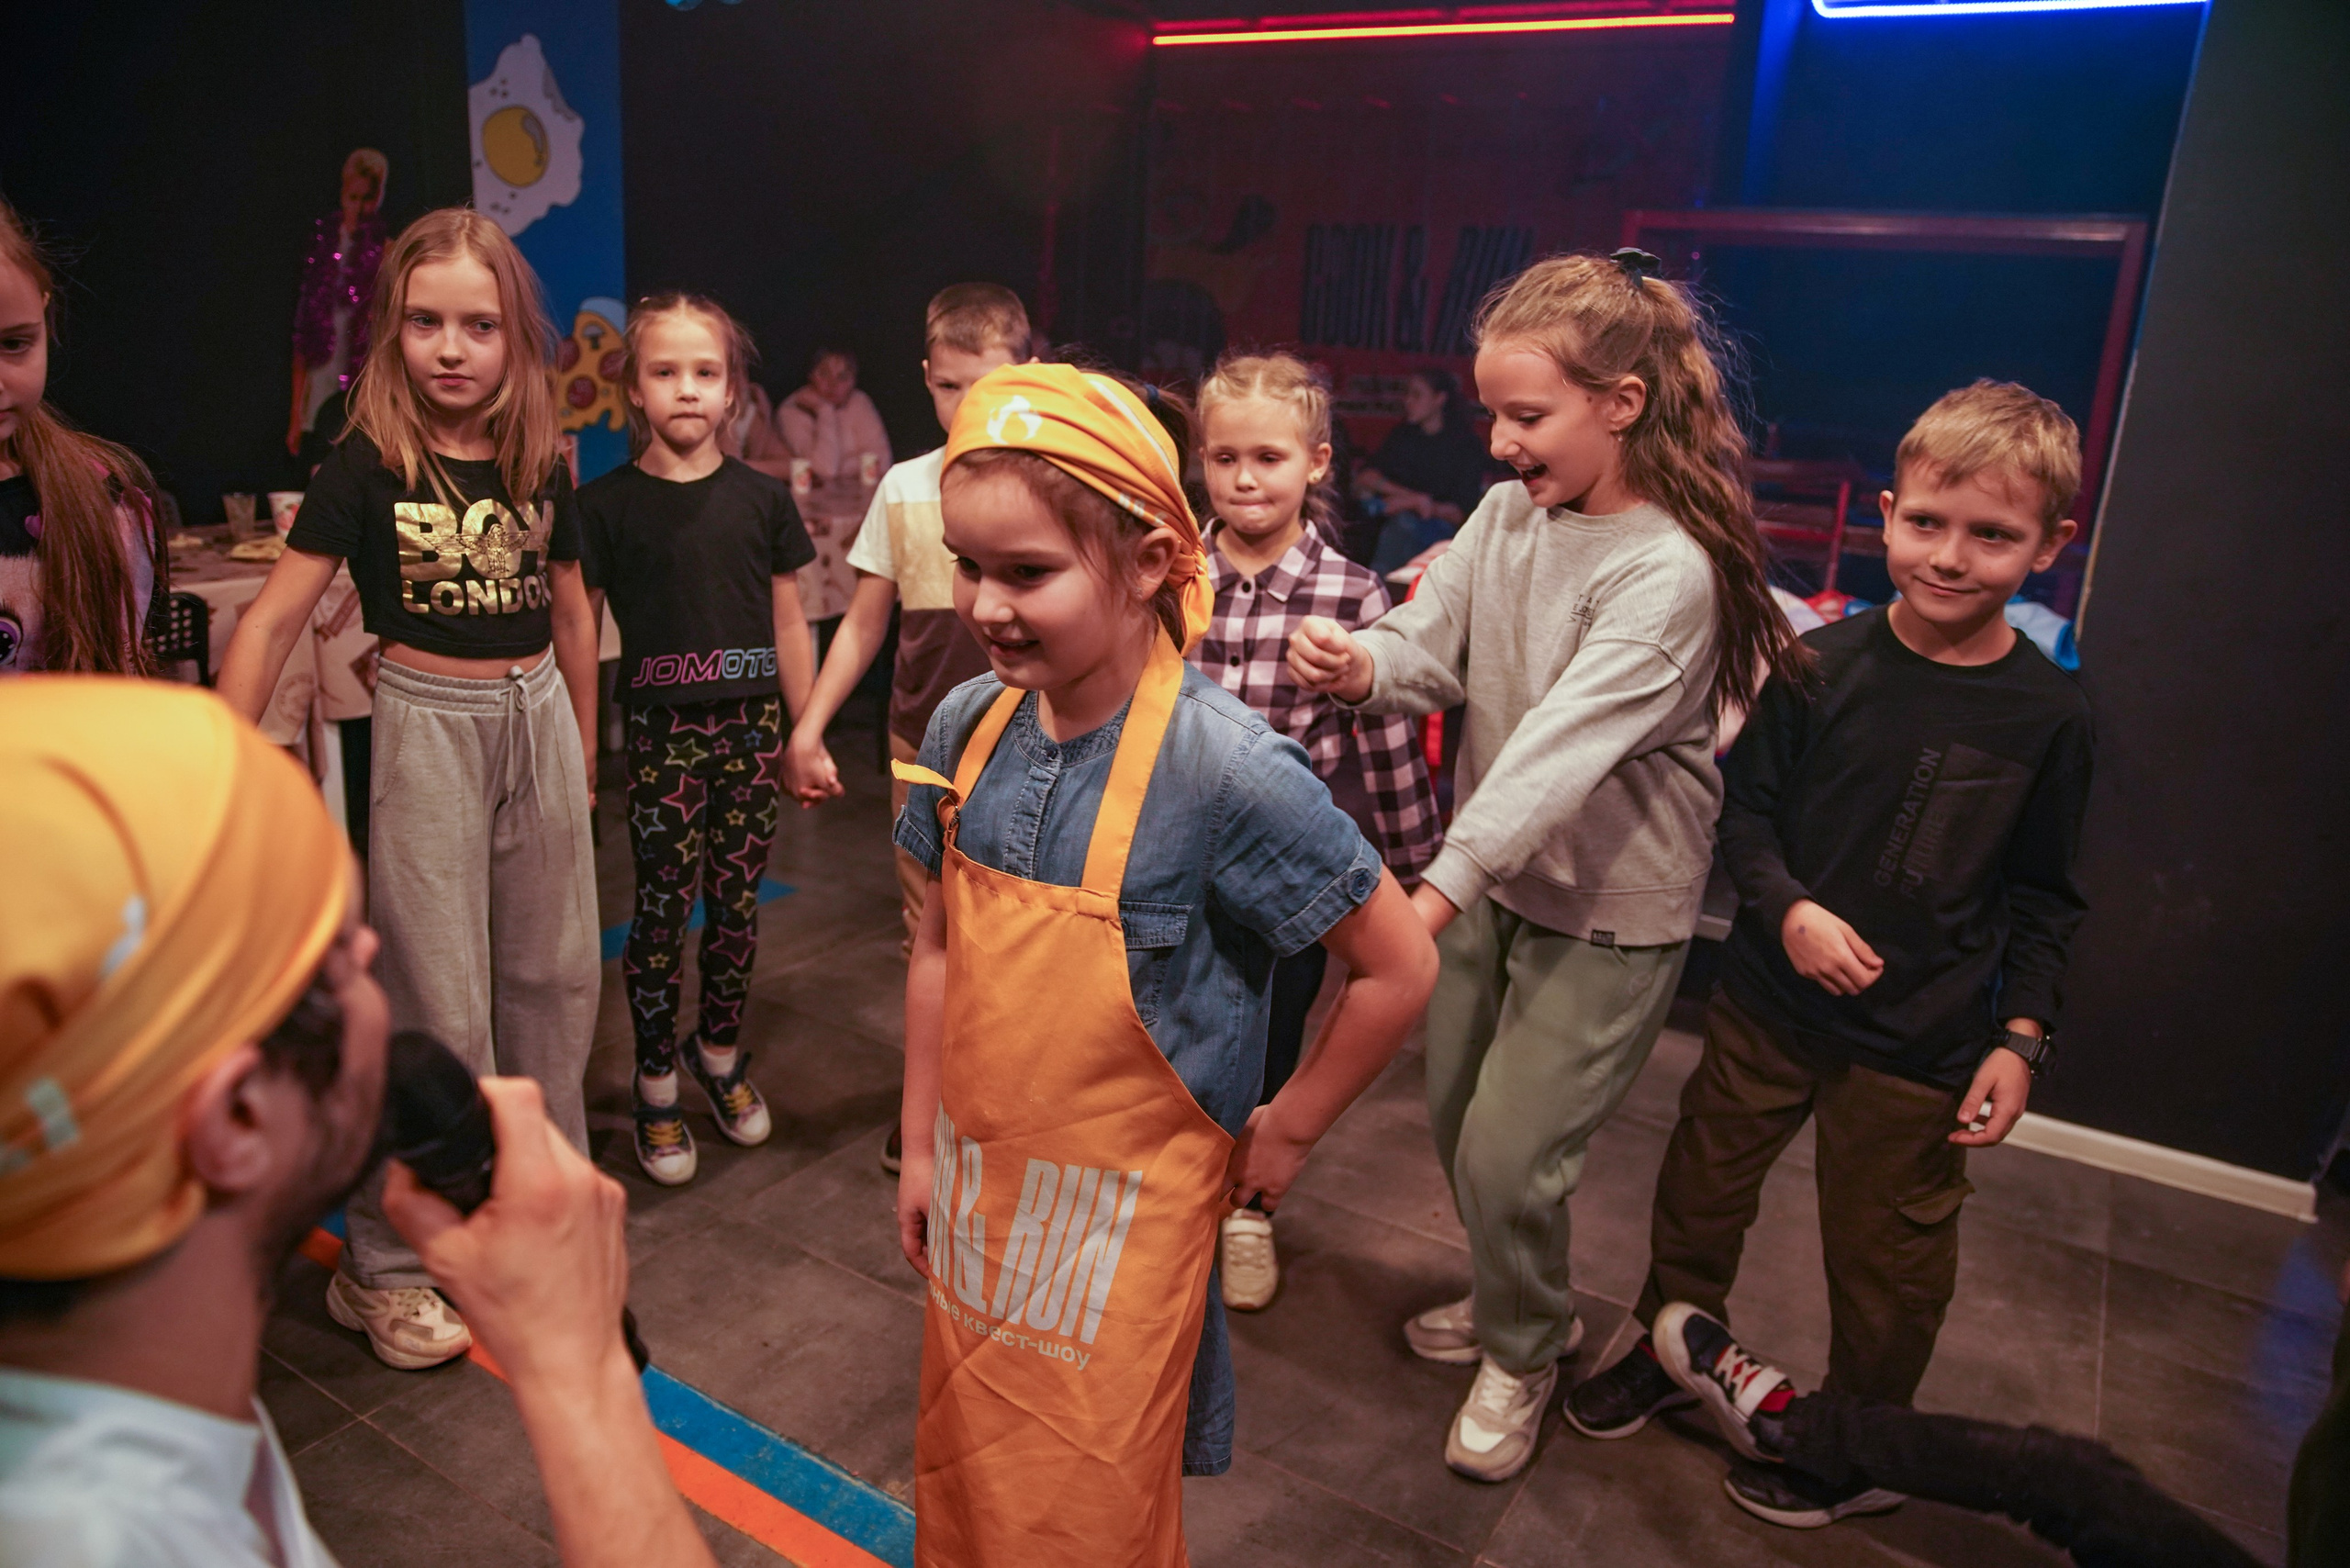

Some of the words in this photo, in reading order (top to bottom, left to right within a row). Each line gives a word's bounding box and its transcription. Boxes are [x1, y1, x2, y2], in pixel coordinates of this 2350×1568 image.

[394, 498, 554, 581] BOY
[401, 573, 552, 616] LONDON
[1874, 747, 1942, 888] GENERATION
[953, 1135, 987, 1315] &
[990, 1158, 1143, 1345] RUN
[964, 1313, 1091, 1371] квест-шоу
